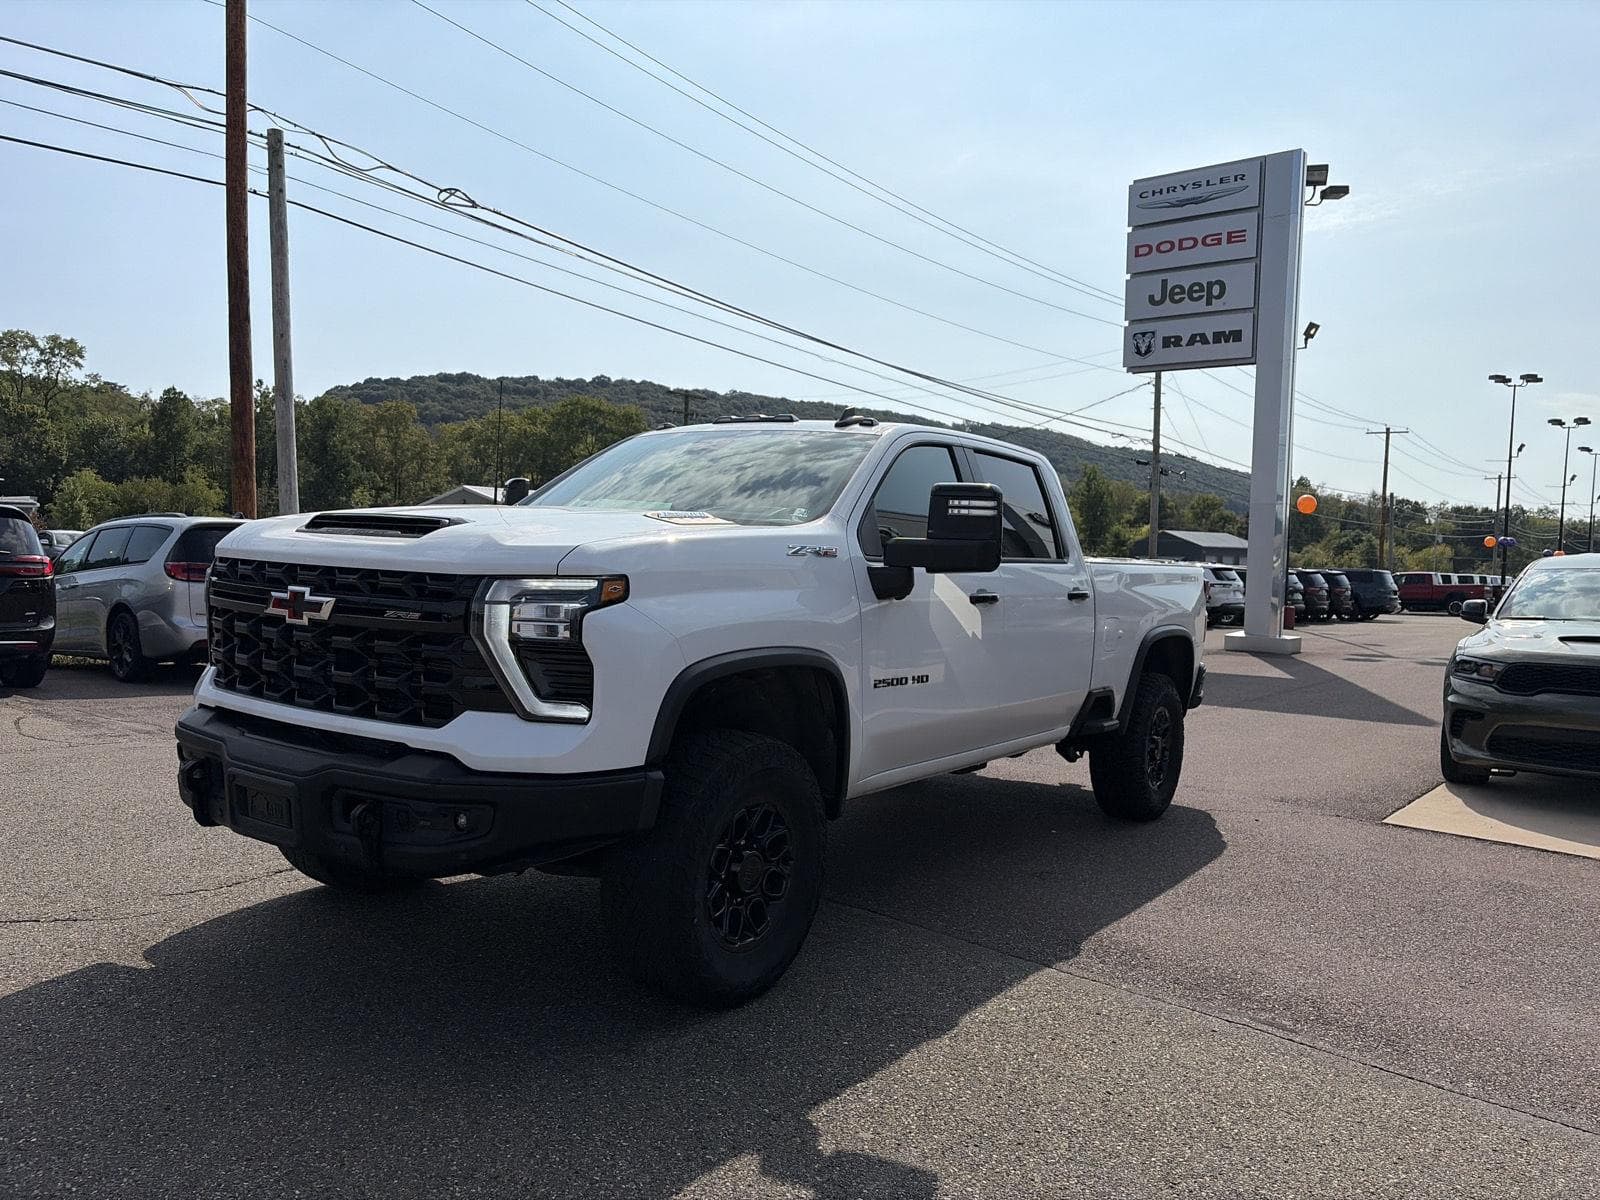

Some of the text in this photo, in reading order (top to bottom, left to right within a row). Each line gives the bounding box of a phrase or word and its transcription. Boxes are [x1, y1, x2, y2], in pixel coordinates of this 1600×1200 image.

[1138, 173, 1247, 199] CHRYSLER
[1134, 229, 1247, 258] DODGE
[1148, 278, 1227, 306] Jeep
[1161, 329, 1243, 349] RAM
[873, 674, 930, 689] 2500 HD
